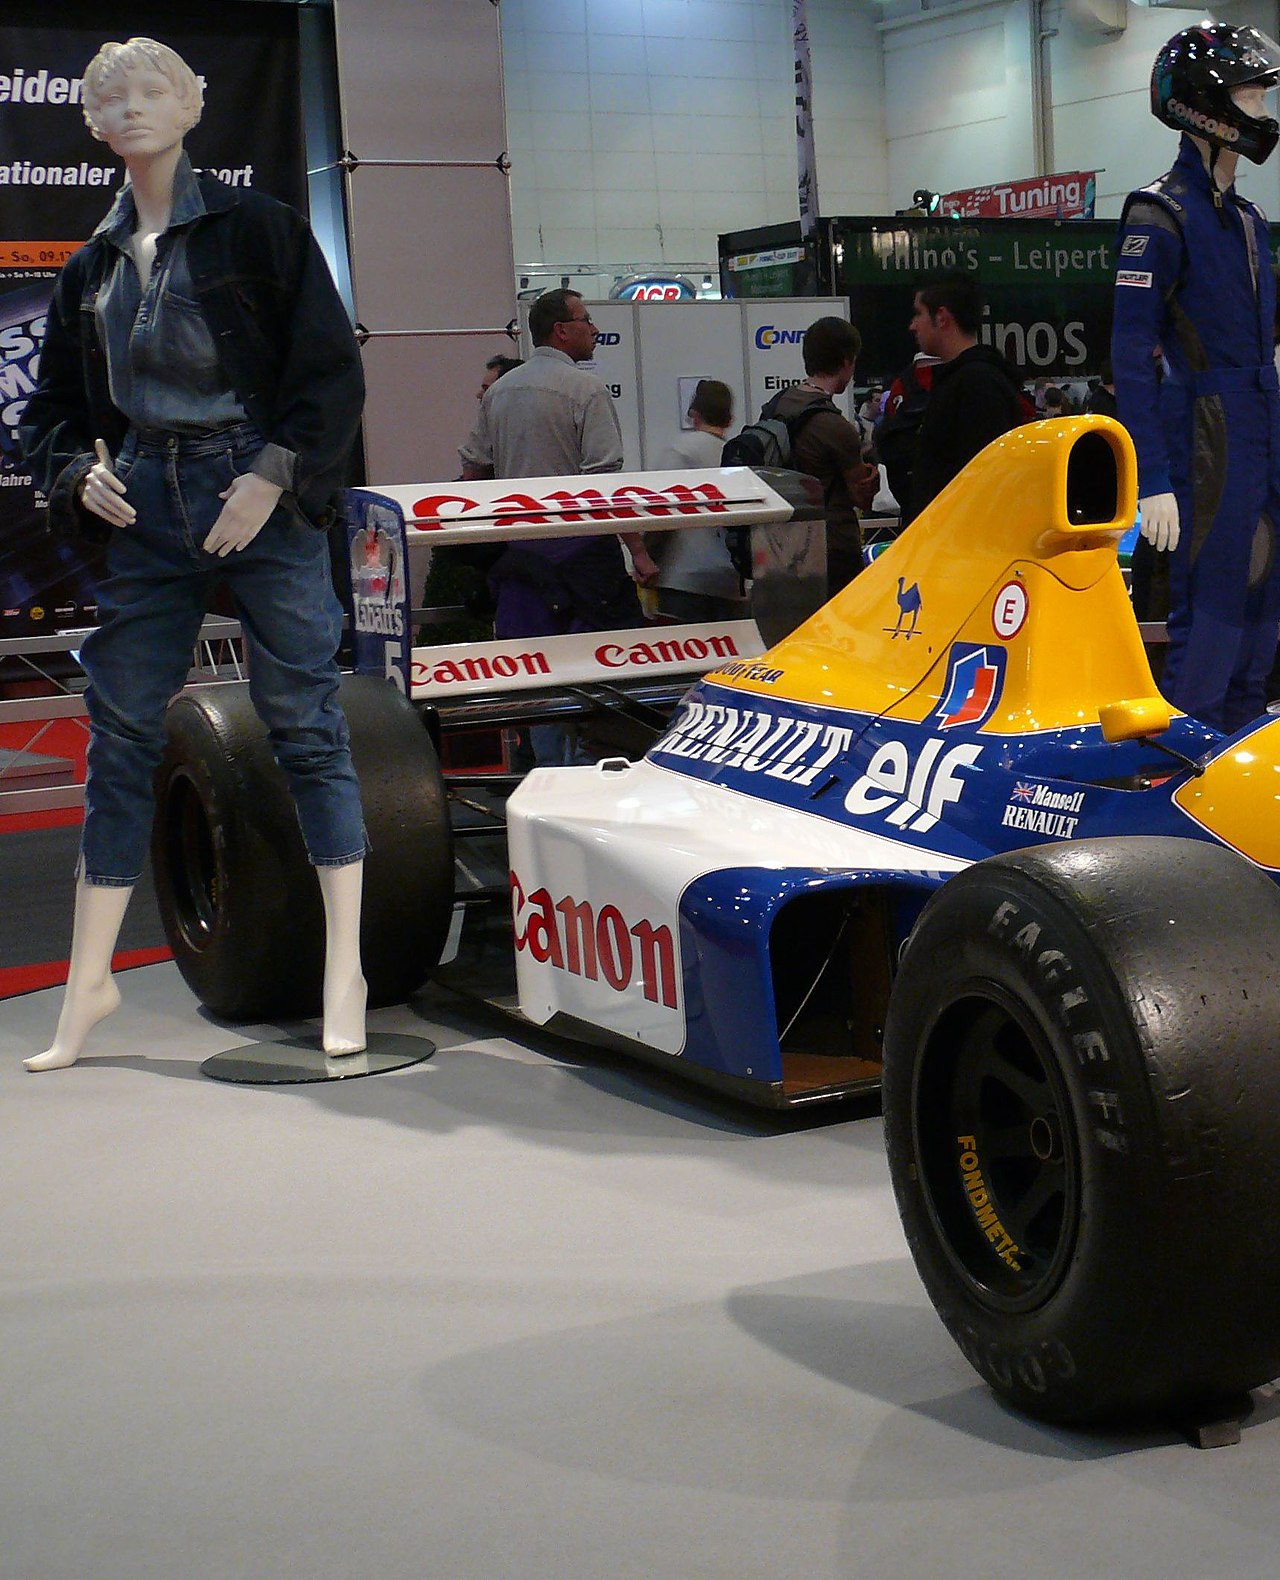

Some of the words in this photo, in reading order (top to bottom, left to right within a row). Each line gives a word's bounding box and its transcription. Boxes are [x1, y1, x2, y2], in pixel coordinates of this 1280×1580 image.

[994, 180, 1080, 214] Tuning
[40, 250, 72, 262] 09.1
[1014, 241, 1109, 277] Leipert
[755, 325, 807, 349] CONR
[981, 304, 1088, 366] inos
[412, 482, 731, 532] Canon
[1003, 598, 1017, 625] E
[384, 641, 406, 698] 5
[594, 635, 740, 668] Canon
[651, 702, 853, 787] RENAULT
[844, 738, 984, 833] elf
[1033, 784, 1086, 813] Mansell
[1002, 804, 1079, 839] RENAULT
[509, 870, 678, 1010] Canon
[957, 1135, 1023, 1272] FONDMETA
